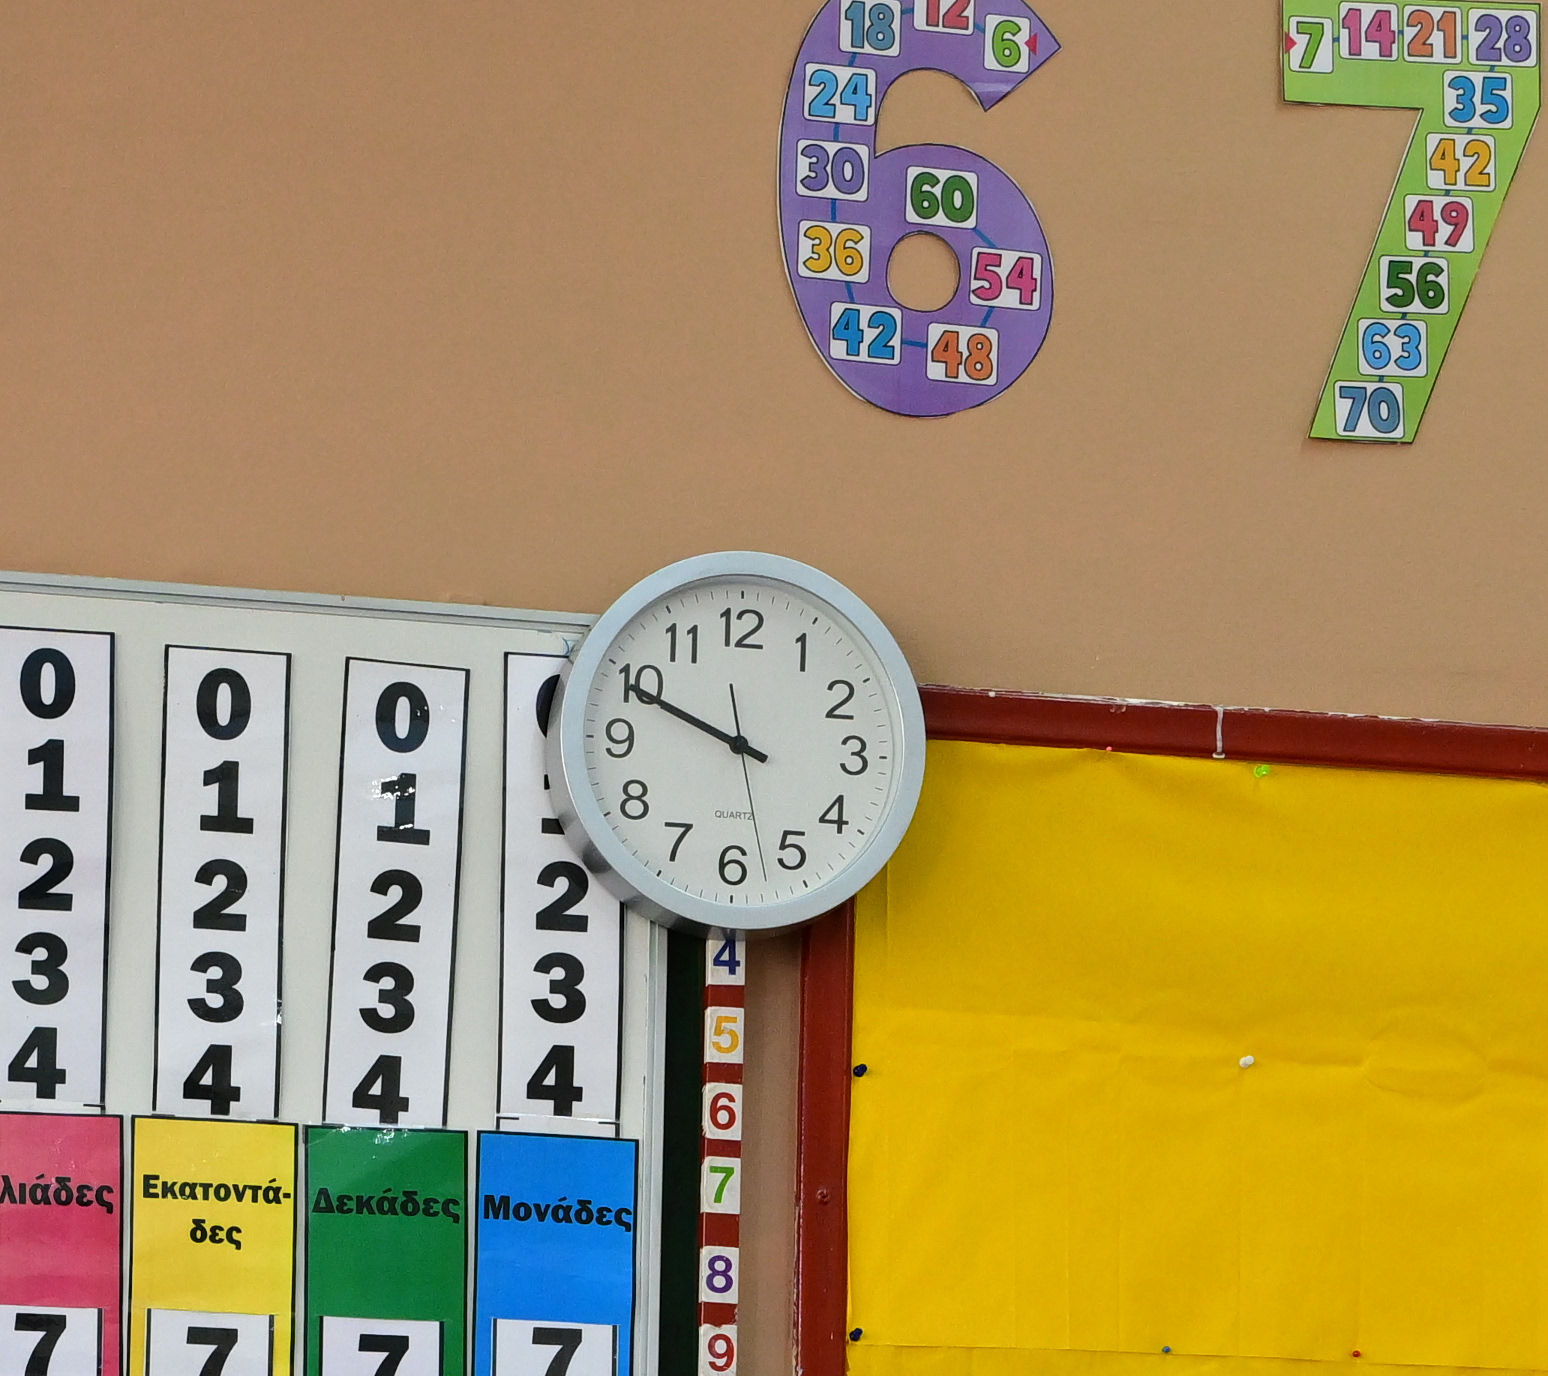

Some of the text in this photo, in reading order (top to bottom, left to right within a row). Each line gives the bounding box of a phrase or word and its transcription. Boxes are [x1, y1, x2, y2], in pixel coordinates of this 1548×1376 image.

[991, 19, 1022, 68] 6
[1295, 8, 1532, 69] 7 14 21 28
[808, 69, 872, 122] 24
[800, 143, 865, 195] 30
[971, 253, 1037, 306] 54
[1385, 260, 1445, 309] 56
[719, 606, 765, 650] 12
[20, 647, 76, 719] 0
[618, 663, 664, 705] 10
[604, 718, 635, 759] 9
[839, 735, 869, 776] 3
[714, 809, 753, 821] QUARTZ
[18, 838, 74, 911] 2
[718, 845, 748, 886] 6
[711, 1015, 740, 1054] 5
[142, 1174, 292, 1206] Εκατοντά-
[313, 1186, 461, 1224] Δεκάδες
[483, 1194, 633, 1233] Μονάδες
[189, 1219, 243, 1250] δες
[705, 1254, 734, 1294] 8
